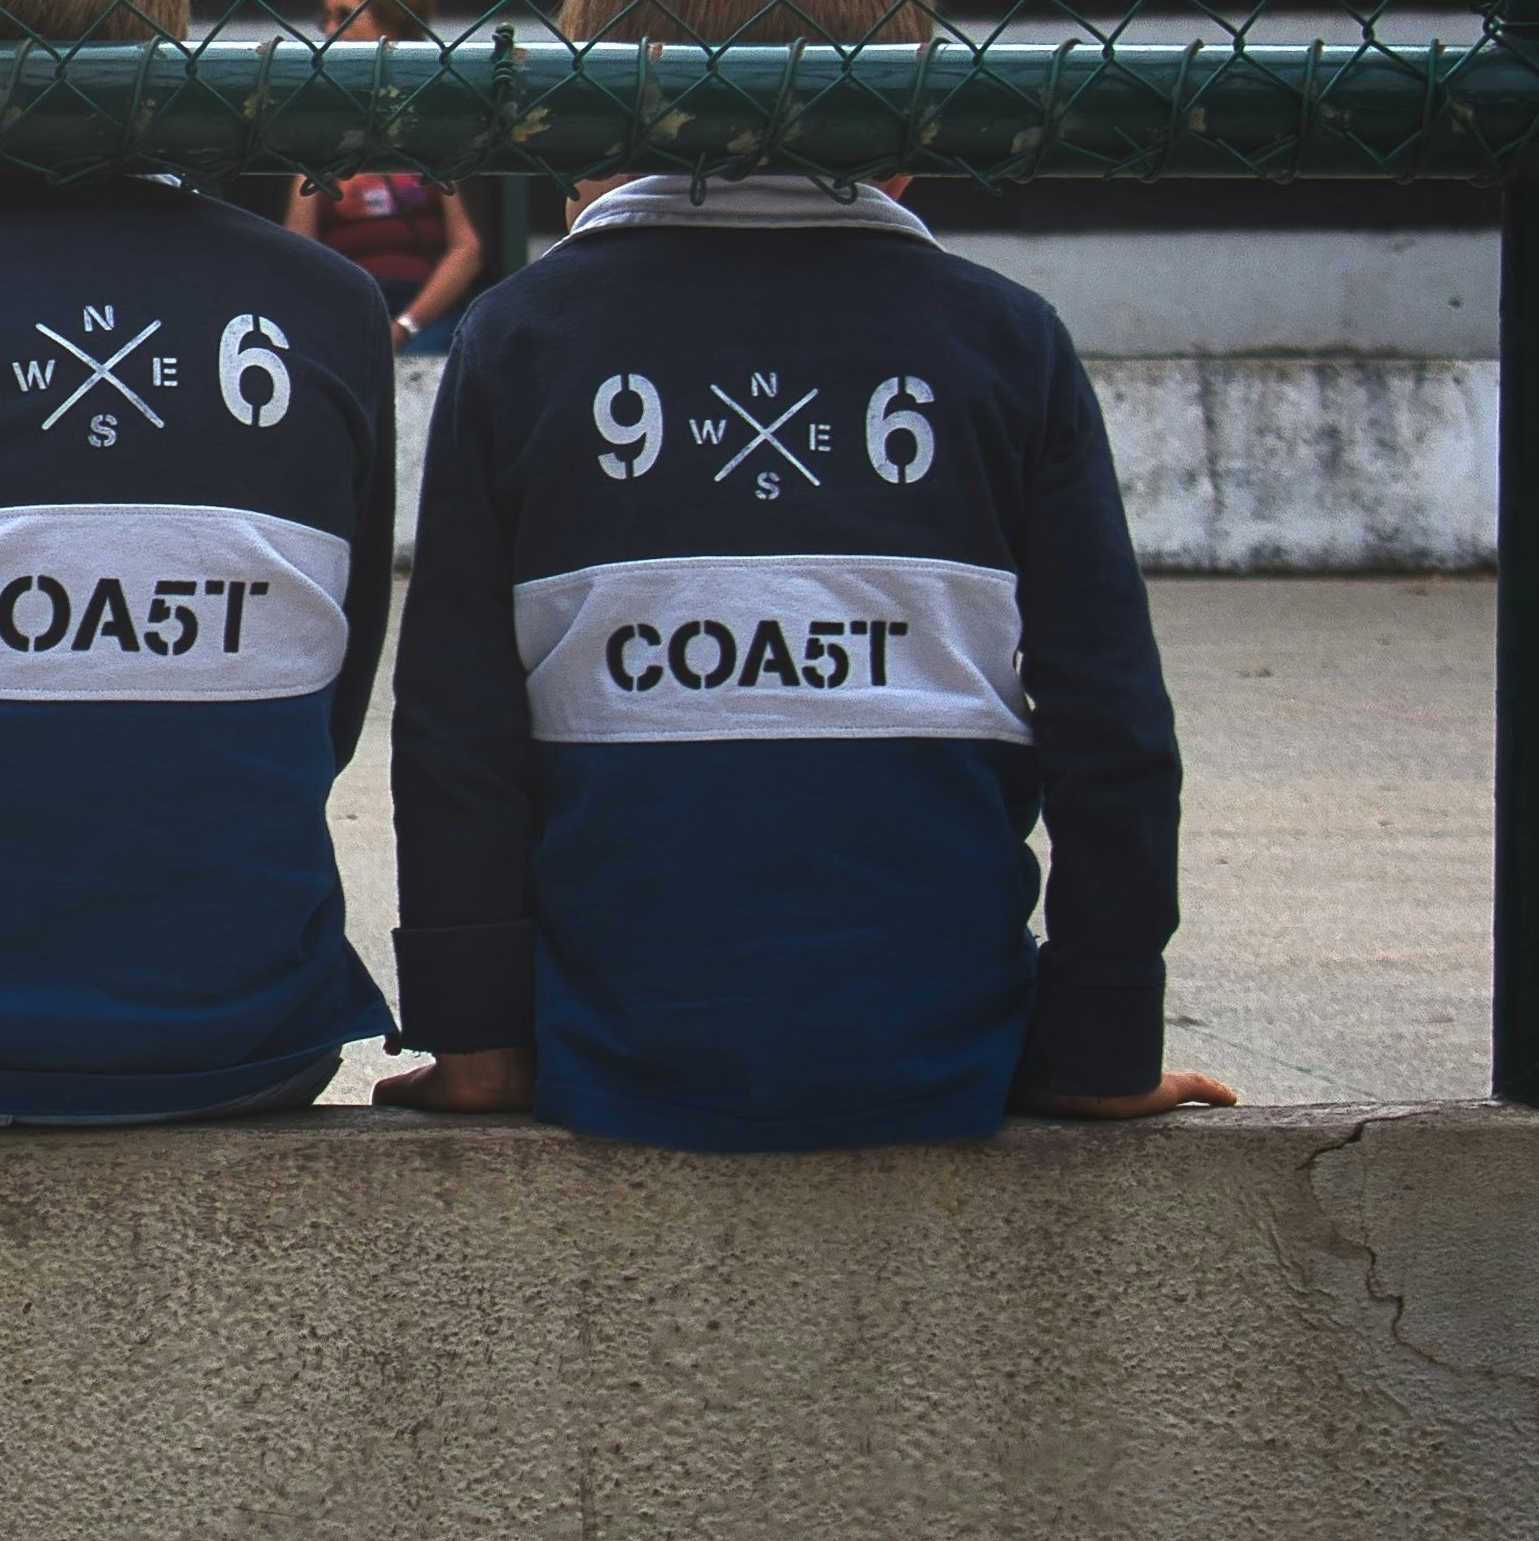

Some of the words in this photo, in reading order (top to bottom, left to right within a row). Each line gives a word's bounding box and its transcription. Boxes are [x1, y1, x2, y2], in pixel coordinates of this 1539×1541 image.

[83, 305, 115, 332] N
[12, 359, 56, 392] W
[152, 357, 178, 387] E
[218, 313, 291, 428] 6
[751, 372, 778, 398] N
[87, 414, 118, 448] S
[592, 373, 664, 480] 9
[688, 419, 727, 445] W
[809, 423, 832, 452] E
[865, 375, 935, 485] 6
[754, 472, 781, 500] S
